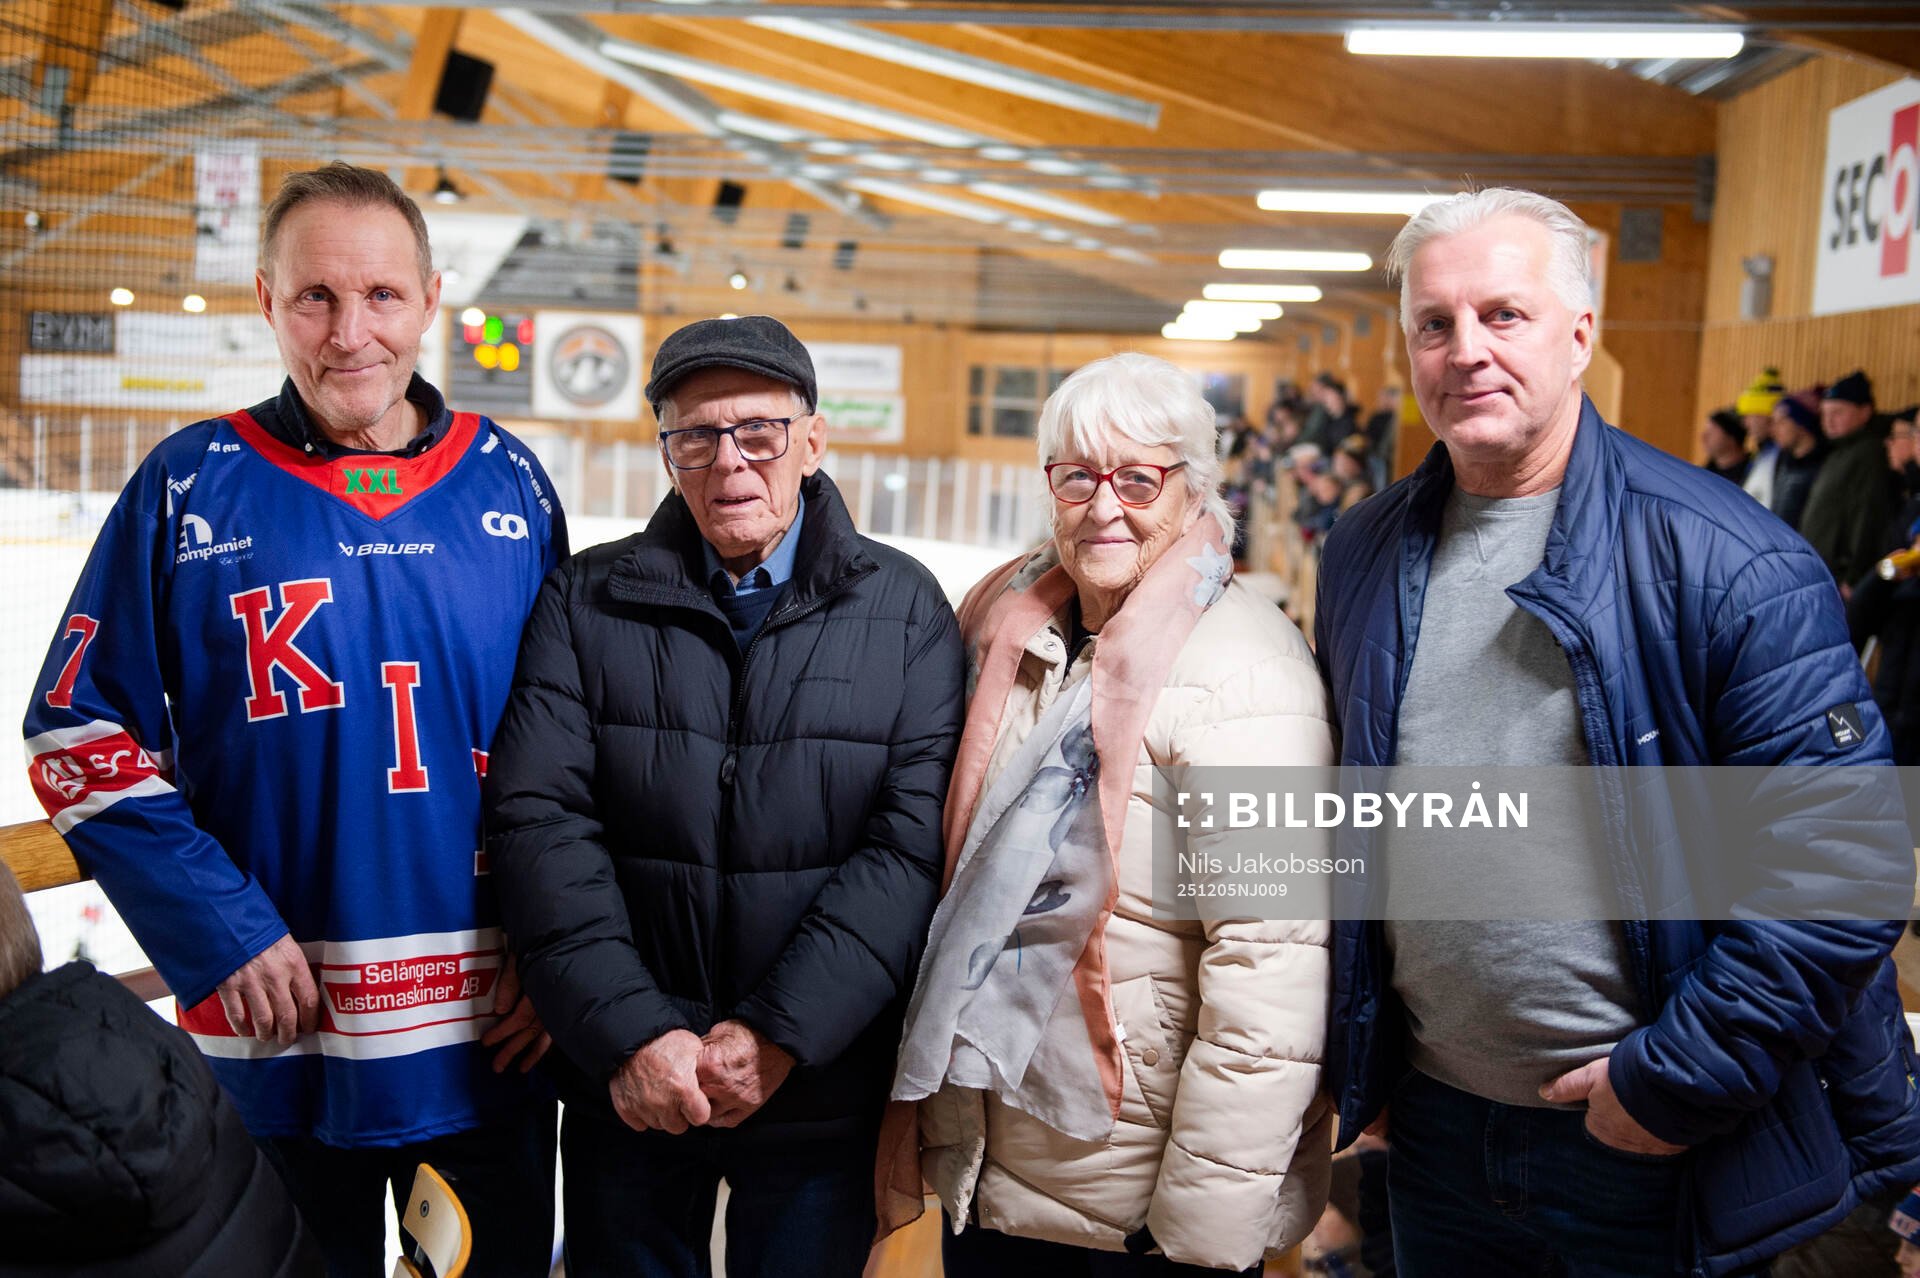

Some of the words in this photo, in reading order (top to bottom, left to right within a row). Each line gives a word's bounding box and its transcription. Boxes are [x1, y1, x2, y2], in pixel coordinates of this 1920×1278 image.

[1831, 142, 1920, 252] SECO
[342, 468, 403, 495] XXL
[481, 511, 530, 540] CO
[45, 613, 100, 710] 7
[229, 577, 346, 723] K
[381, 661, 429, 794] I
[364, 961, 457, 985] Selångers
[336, 984, 455, 1012] Lastmaskiner
[458, 976, 480, 998] AB
